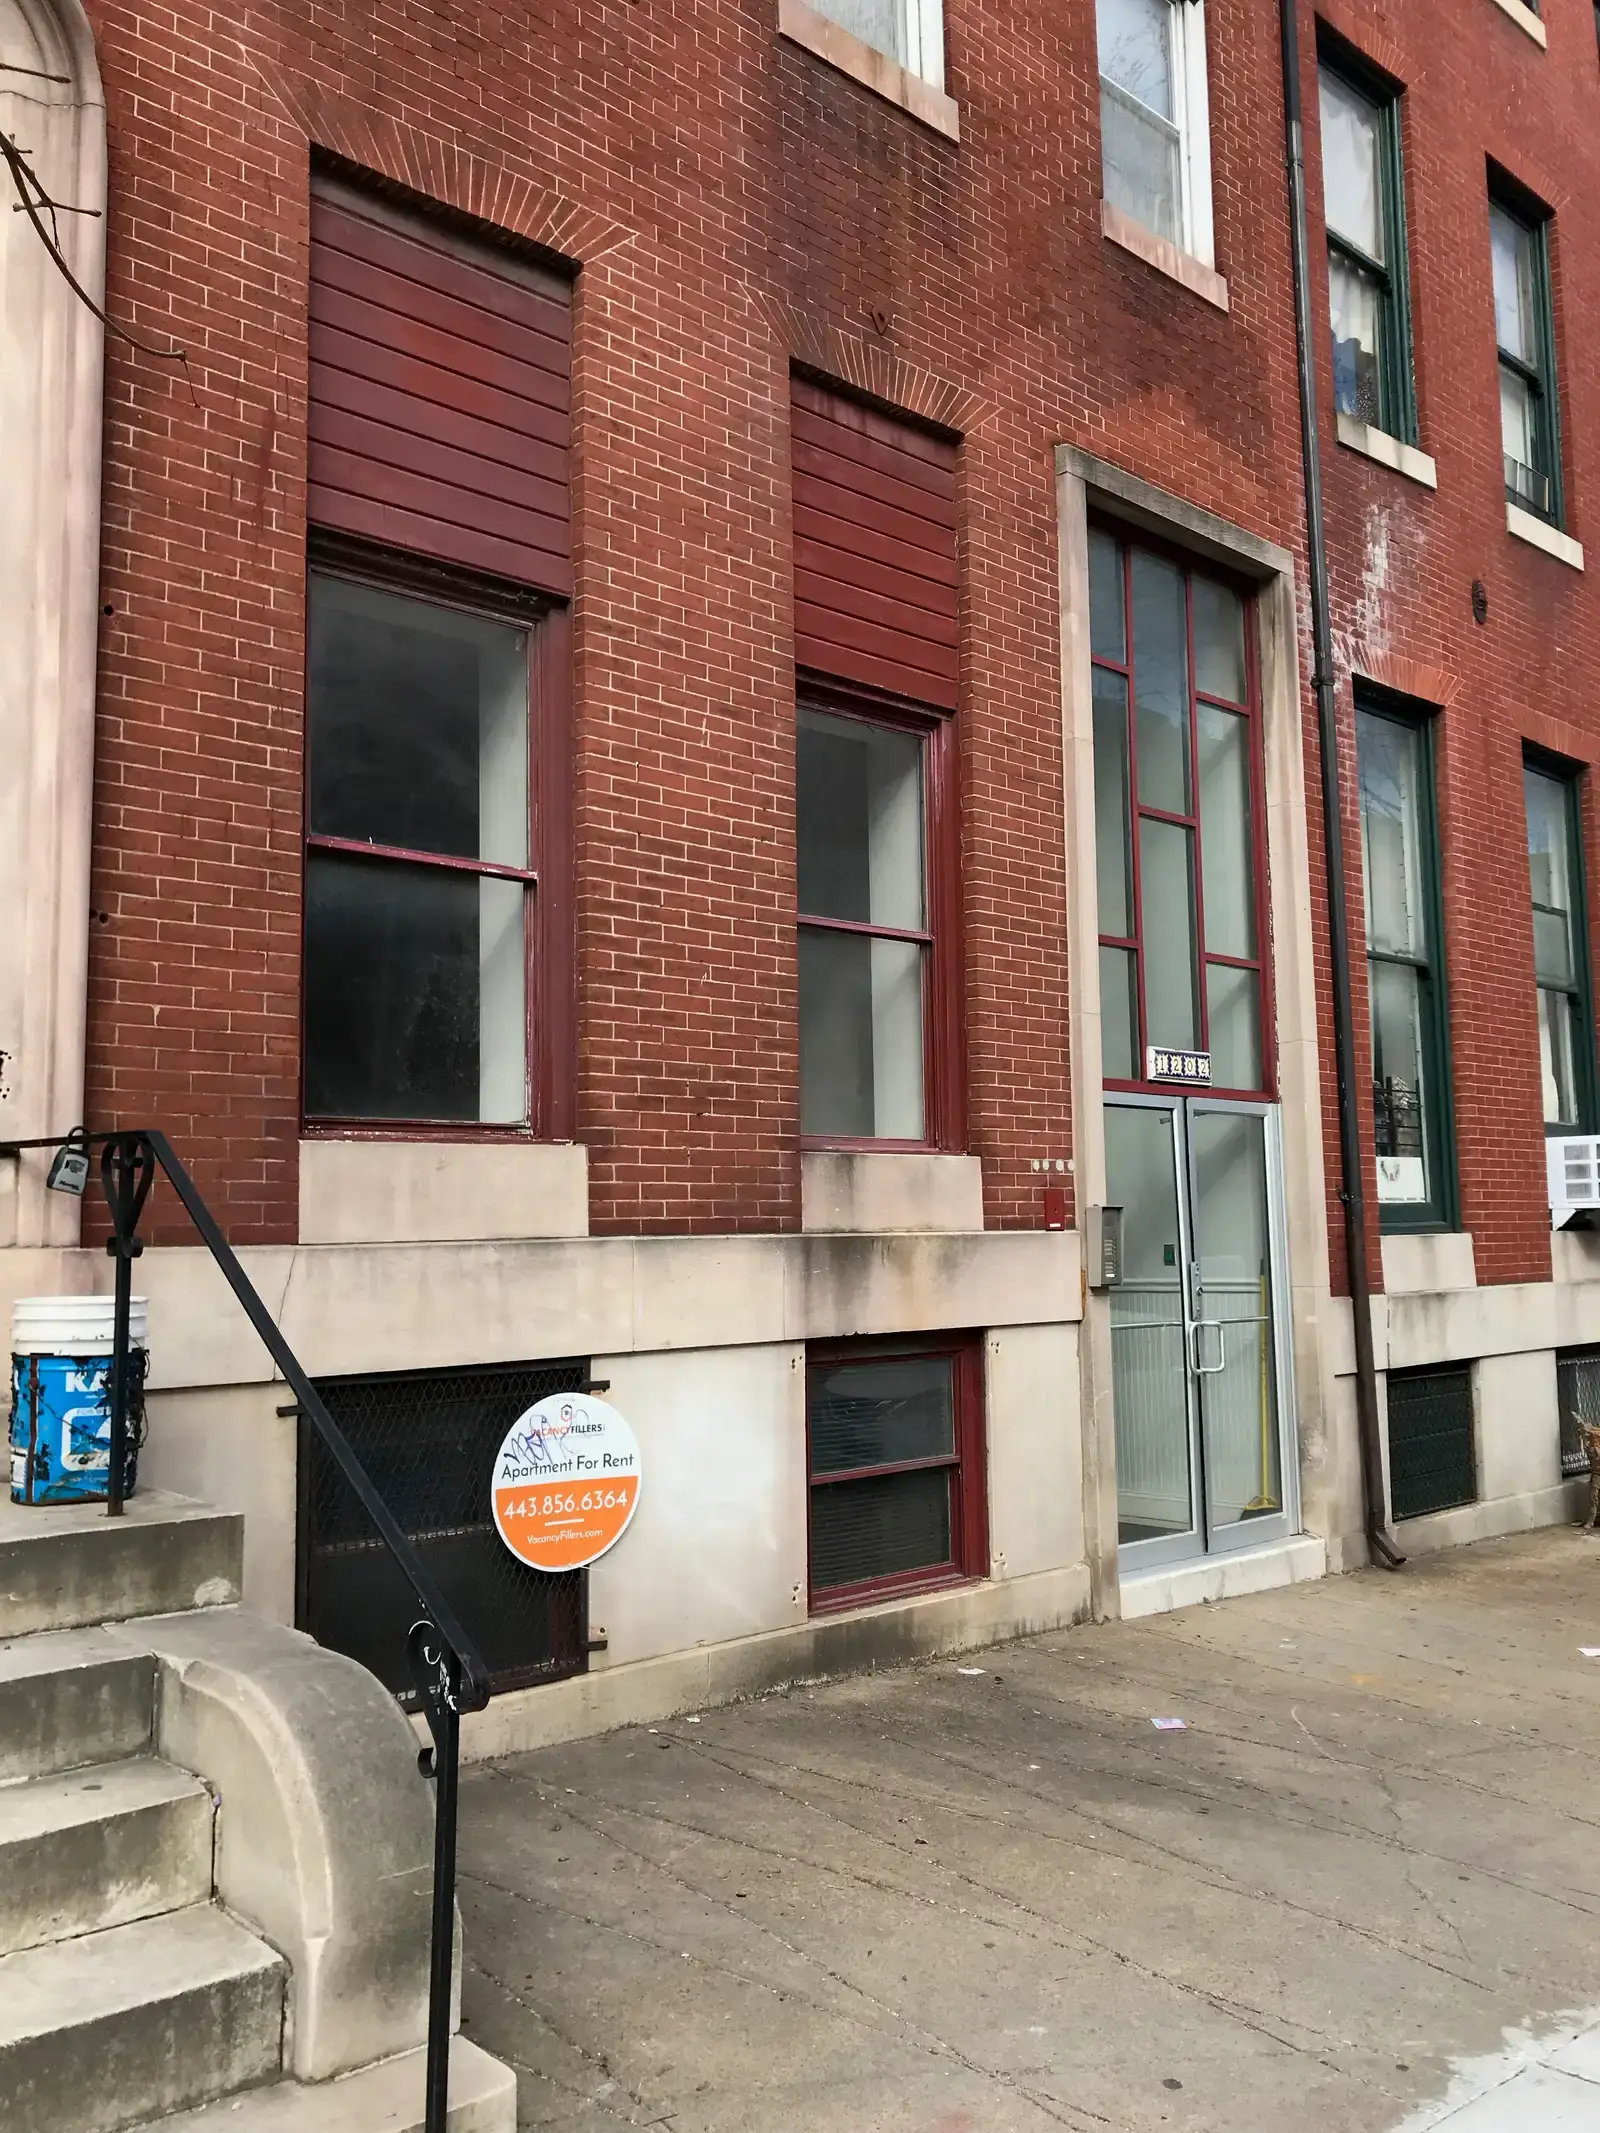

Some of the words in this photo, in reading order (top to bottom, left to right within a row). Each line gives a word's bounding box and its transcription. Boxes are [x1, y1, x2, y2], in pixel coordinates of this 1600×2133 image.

[1160, 1057, 1207, 1075] 1202
[501, 1459, 573, 1481] Apartment
[576, 1455, 599, 1470] For
[602, 1453, 634, 1468] Rent
[503, 1488, 628, 1520] 443.856.6364
[527, 1528, 603, 1545] VacancyFillers.com
